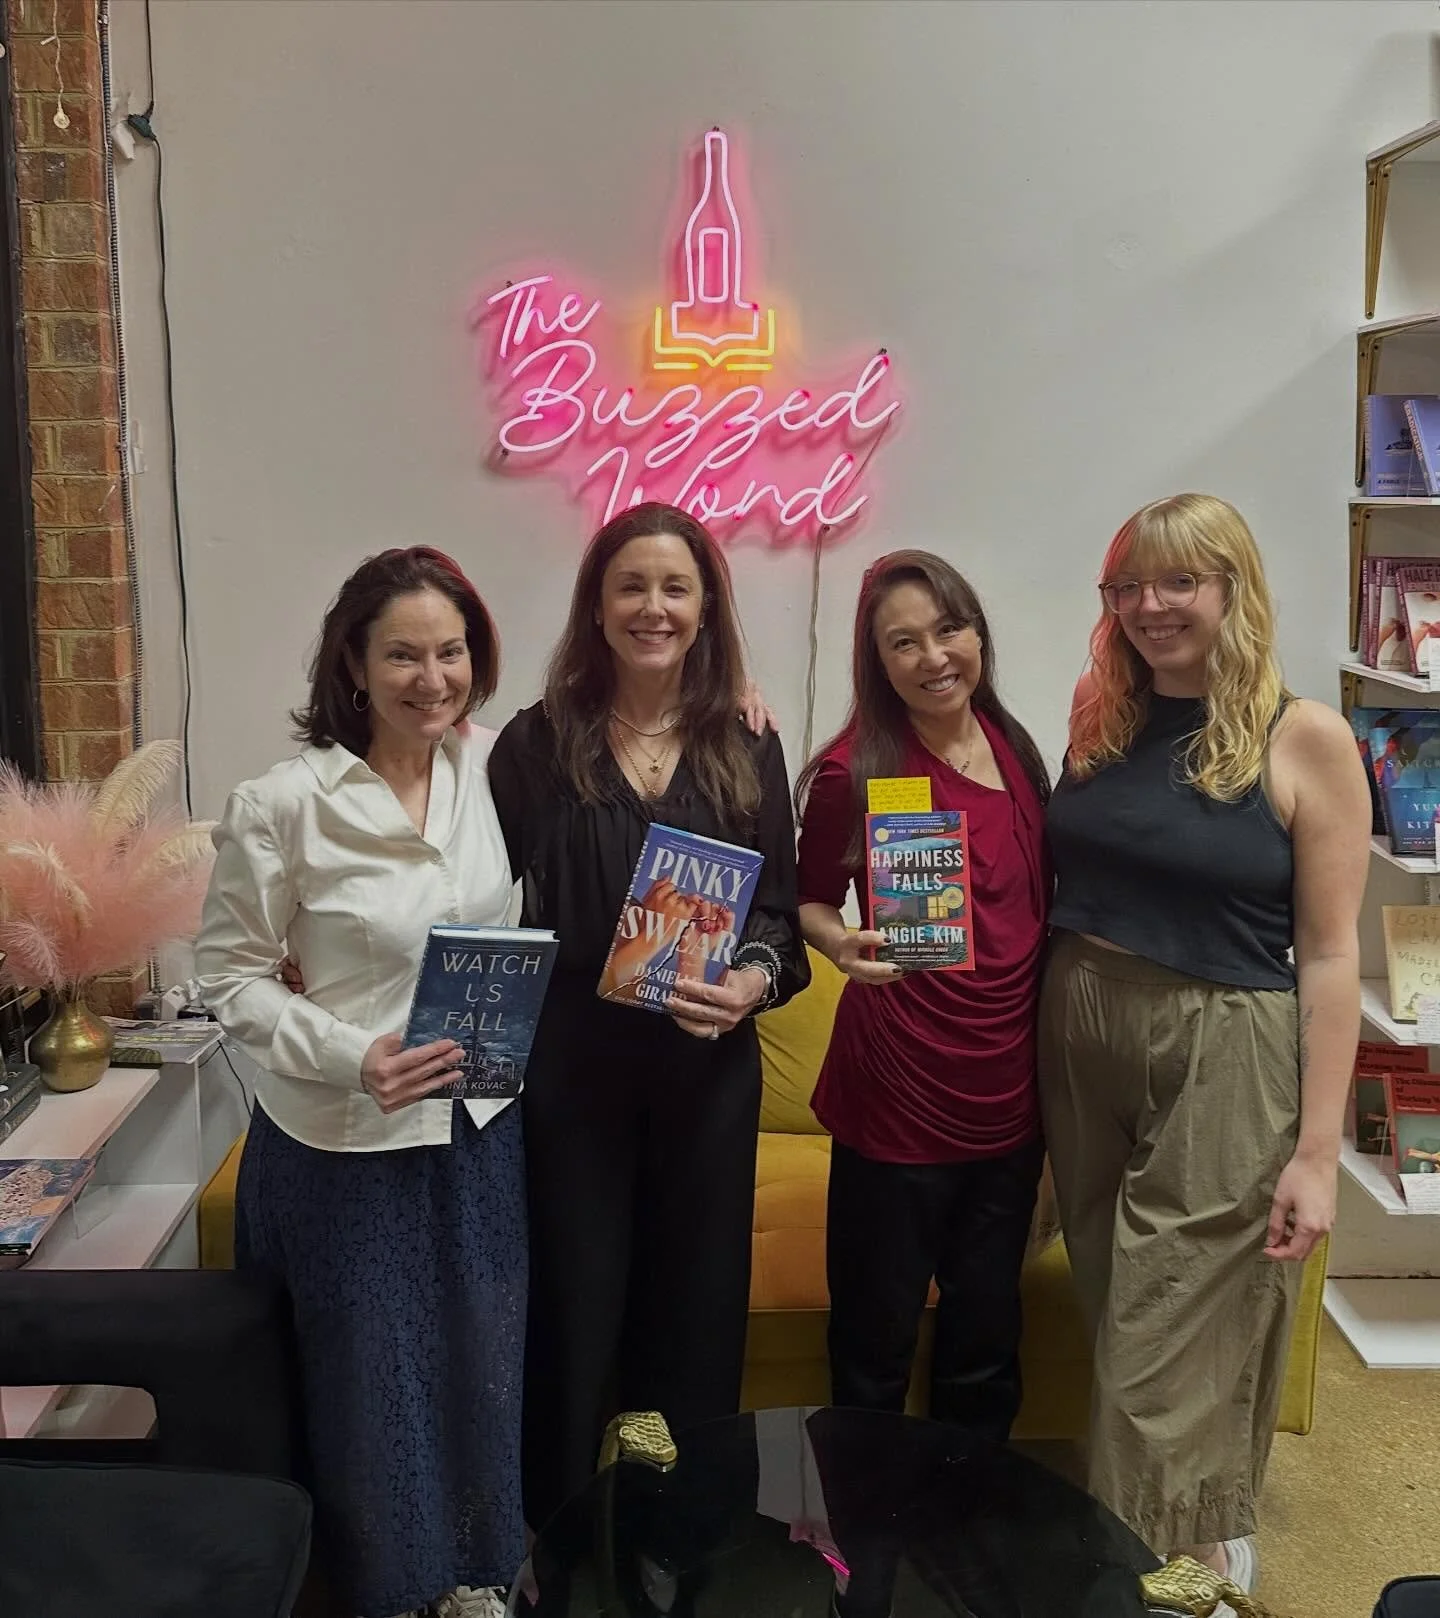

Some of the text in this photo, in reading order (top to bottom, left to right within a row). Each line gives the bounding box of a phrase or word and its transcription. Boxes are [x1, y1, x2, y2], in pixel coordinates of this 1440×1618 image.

[487, 275, 601, 358] The
[500, 339, 901, 470] Buzzed
[587, 446, 871, 527] Word
[1404, 568, 1433, 583] HALF
[870, 850, 964, 868] HAPPINESS
[648, 847, 753, 904] PINKY
[892, 872, 944, 891] FALLS
[621, 905, 738, 966] SWEAR
[879, 926, 965, 944] ANGIE KIM
[442, 951, 542, 975] WATCH
[465, 983, 504, 1003] US
[443, 1011, 507, 1031] FALL
[471, 1081, 507, 1090] KOVAC
